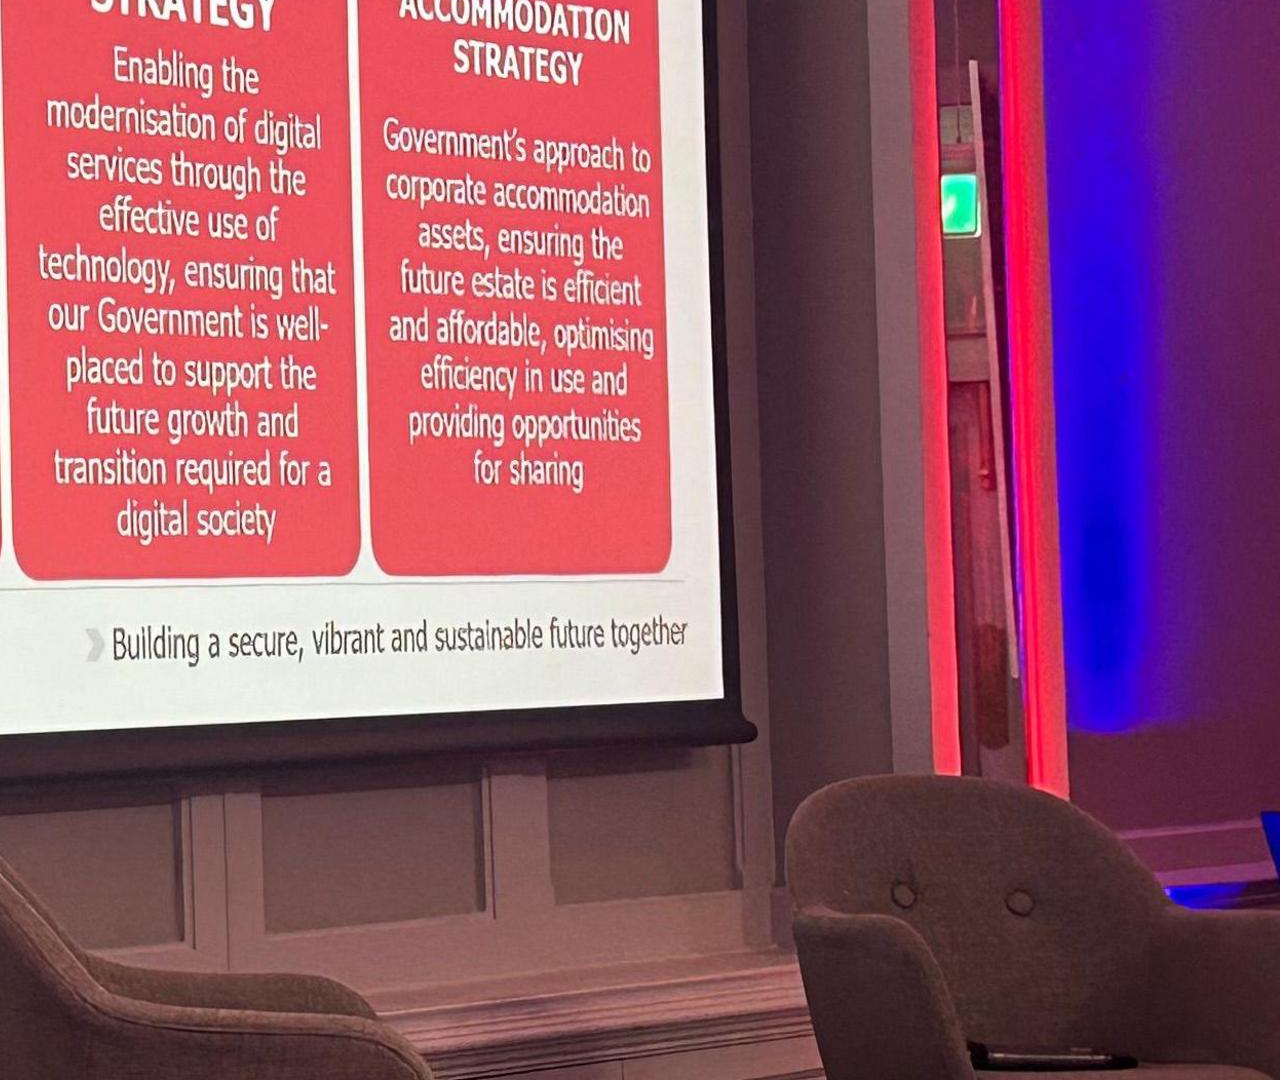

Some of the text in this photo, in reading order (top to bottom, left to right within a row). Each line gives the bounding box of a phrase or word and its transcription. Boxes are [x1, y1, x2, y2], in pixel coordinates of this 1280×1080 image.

[114, 46, 259, 98] Enabling the
[454, 39, 583, 85] STRATEGY
[48, 94, 320, 155] modernisation of digital
[68, 147, 305, 200] services through the
[533, 137, 624, 174] approach
[632, 142, 651, 172] to
[100, 195, 279, 241] effective use of
[387, 173, 649, 217] corporate accommodation
[419, 219, 623, 266] assets, ensuring the
[39, 243, 336, 299] technology, ensuring that
[401, 258, 641, 306] future estate is efficient
[49, 297, 328, 340] our Government is well-
[390, 307, 654, 360] and affordable, optimising
[67, 346, 316, 396] placed to support the
[421, 354, 627, 400] efficiency in use and
[87, 397, 298, 444] future growth and
[409, 403, 641, 447] providing opportunities
[55, 448, 331, 494] transition required for a
[474, 449, 583, 493] for sharing
[117, 499, 276, 545] digital society
[113, 614, 688, 667] Building a secure, vibrant and sustainable future together
